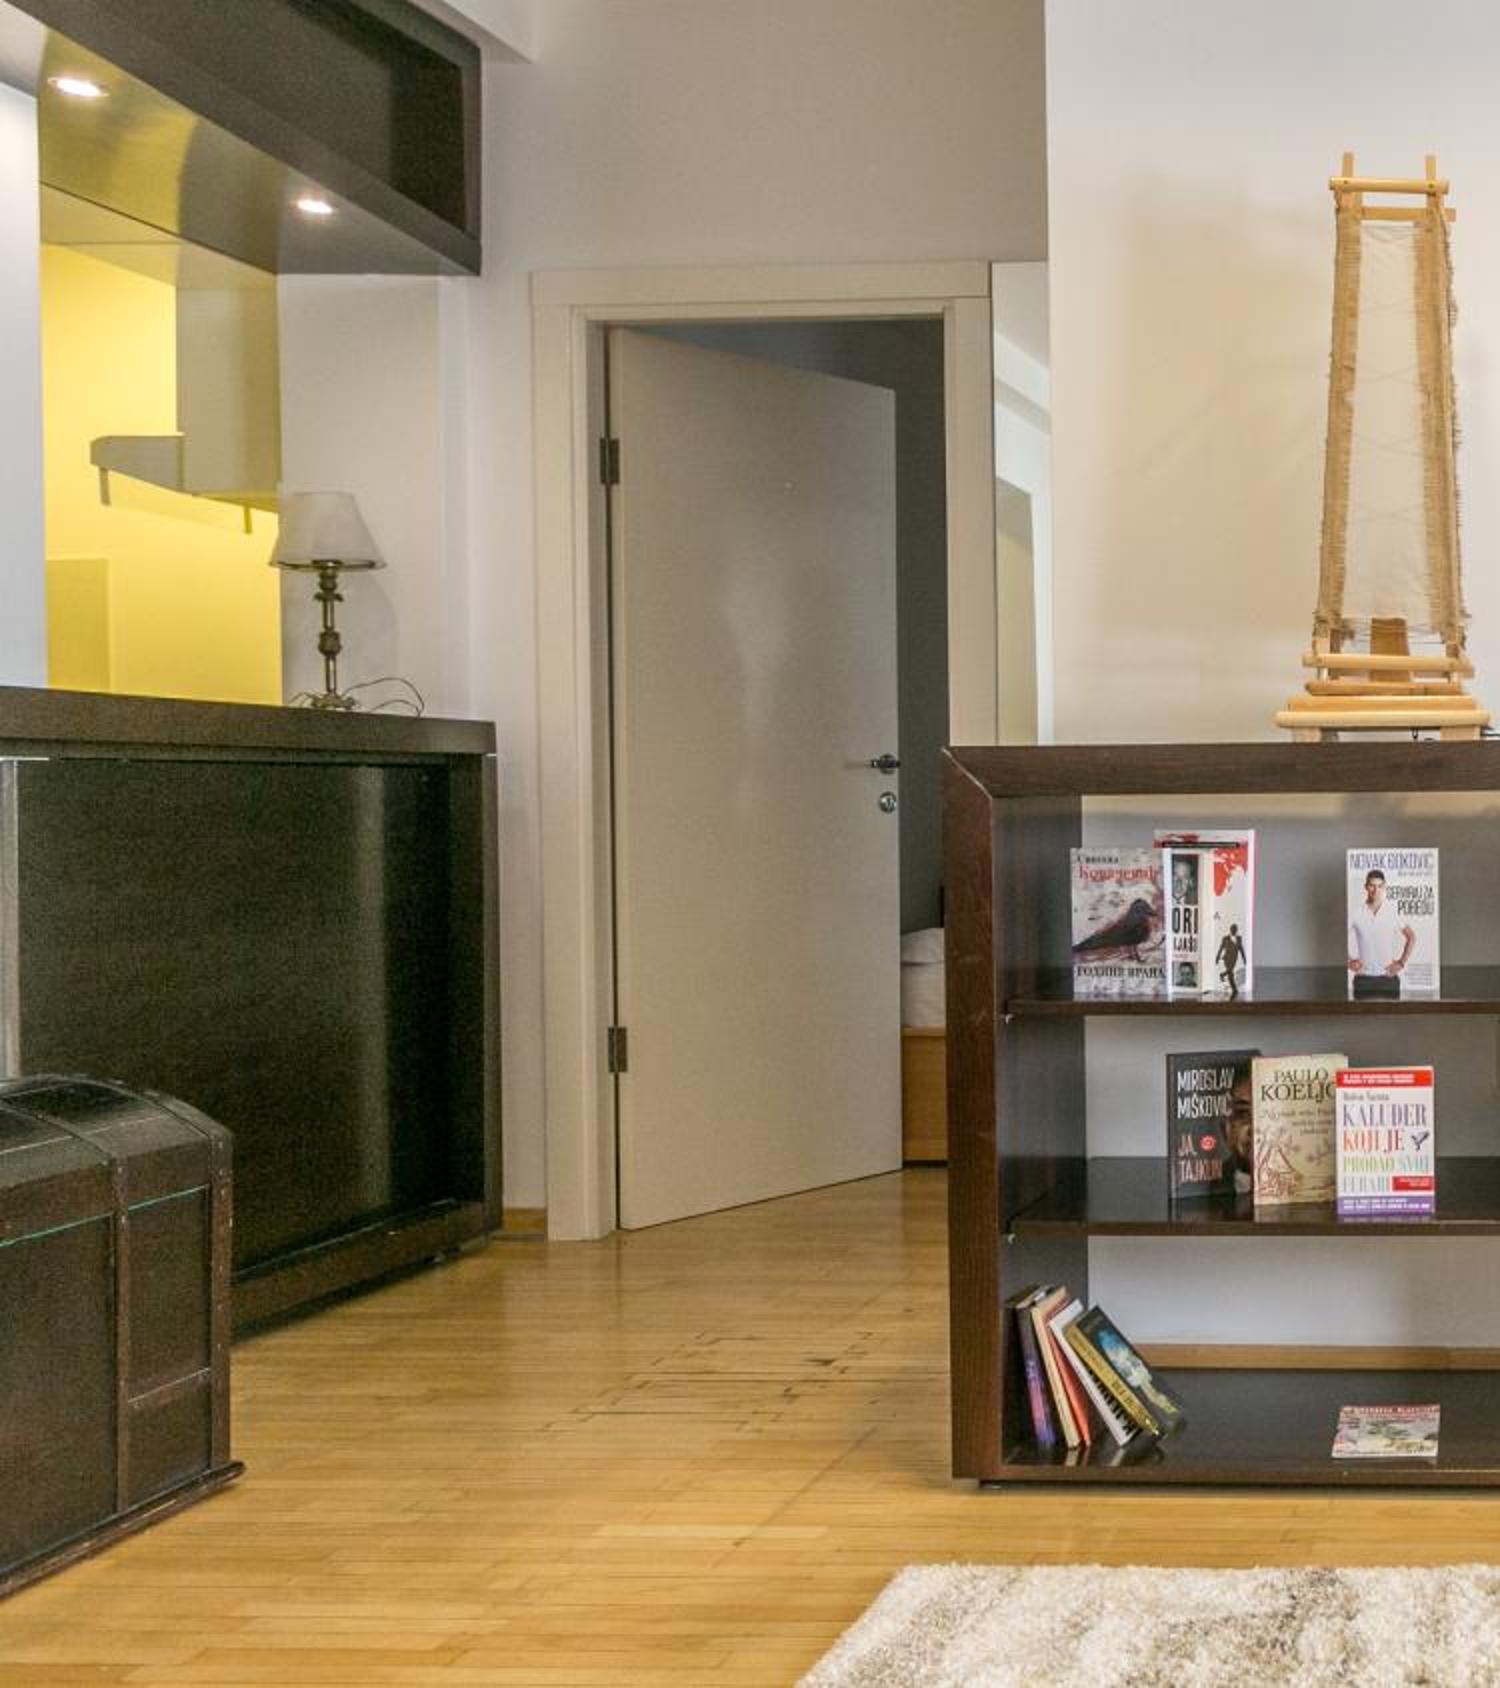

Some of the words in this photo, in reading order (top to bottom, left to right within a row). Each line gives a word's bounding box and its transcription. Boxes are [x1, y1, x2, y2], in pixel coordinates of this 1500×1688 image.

[1177, 1067, 1235, 1092] MIROSLAV
[1274, 1068, 1328, 1083] PAULO
[1177, 1092, 1234, 1118] MIŠKOVIĆ
